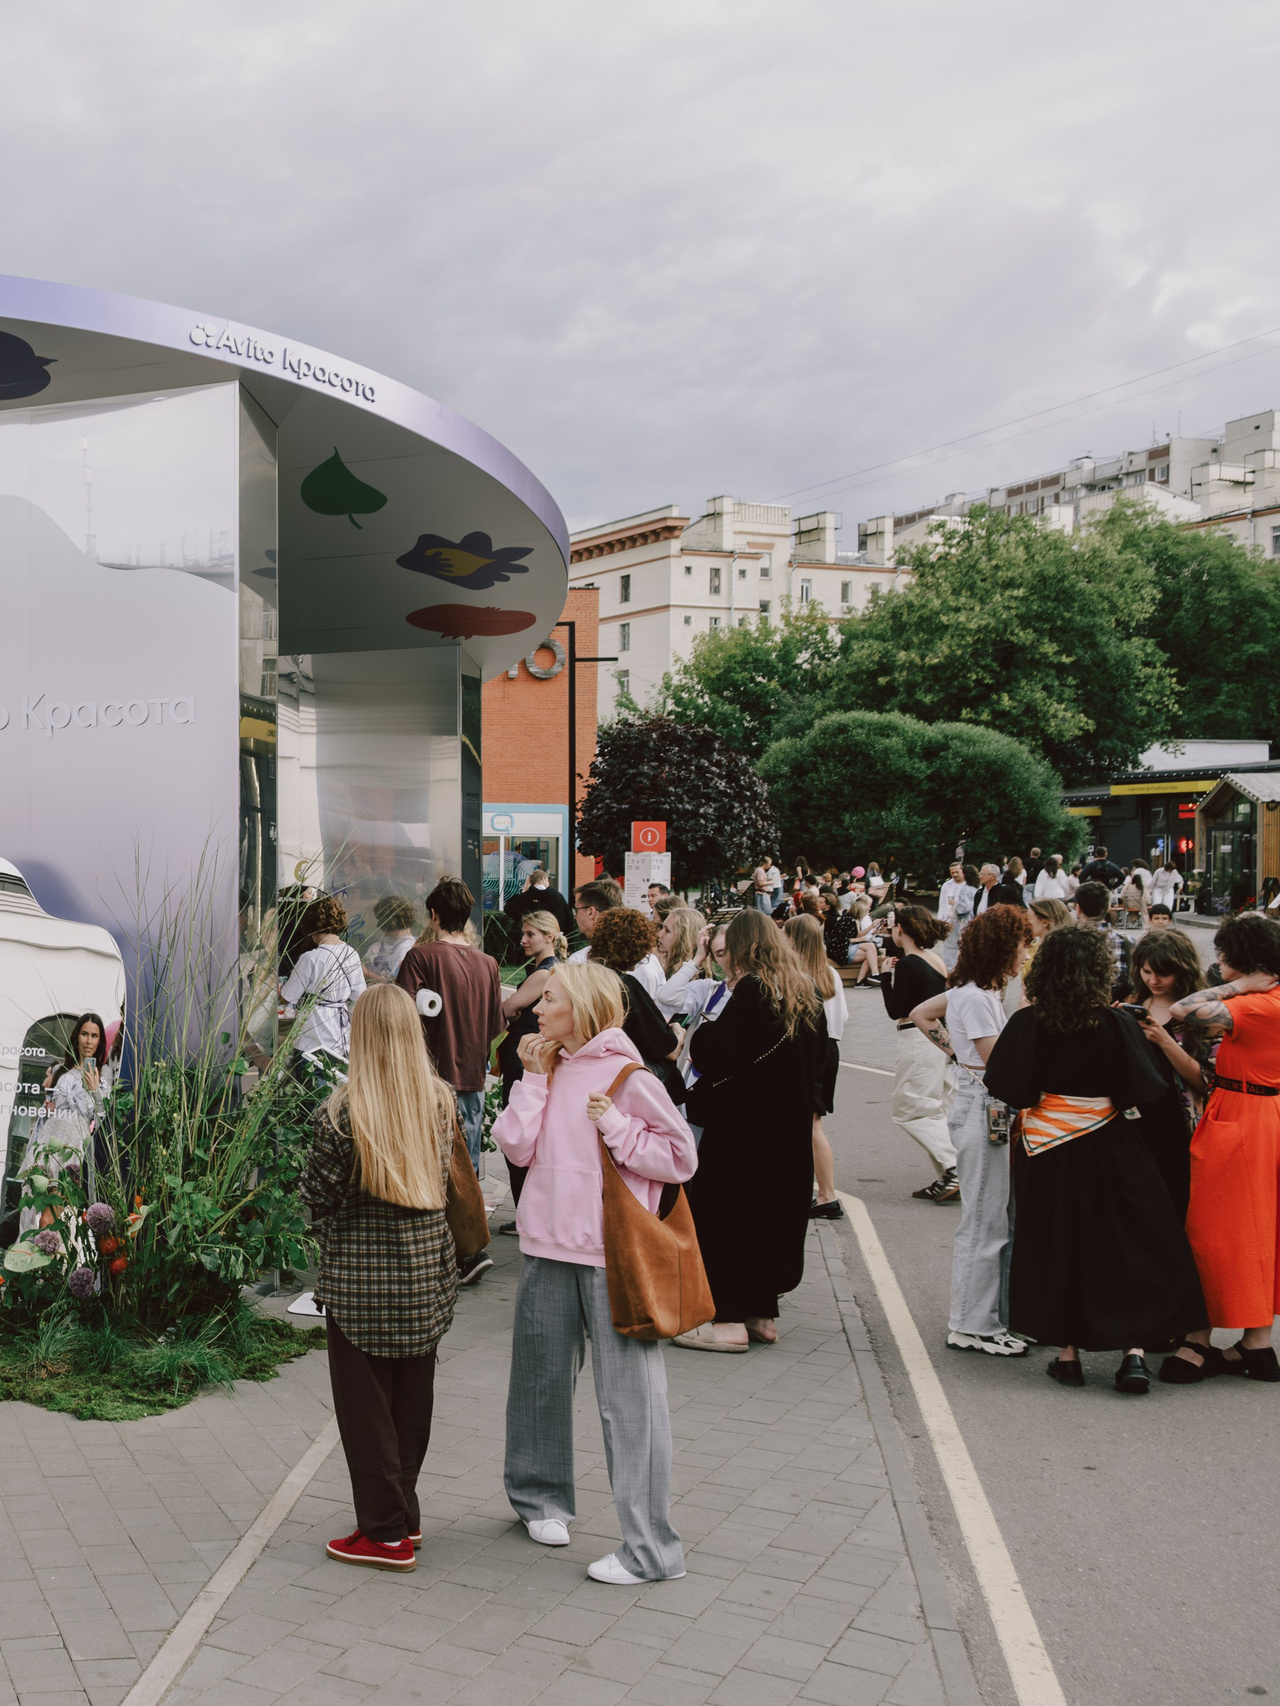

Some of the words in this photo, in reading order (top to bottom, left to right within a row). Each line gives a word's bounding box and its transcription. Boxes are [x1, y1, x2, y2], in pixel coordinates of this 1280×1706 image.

[216, 327, 275, 365] Avito
[282, 347, 376, 403] Красота
[21, 693, 197, 739] Красота
